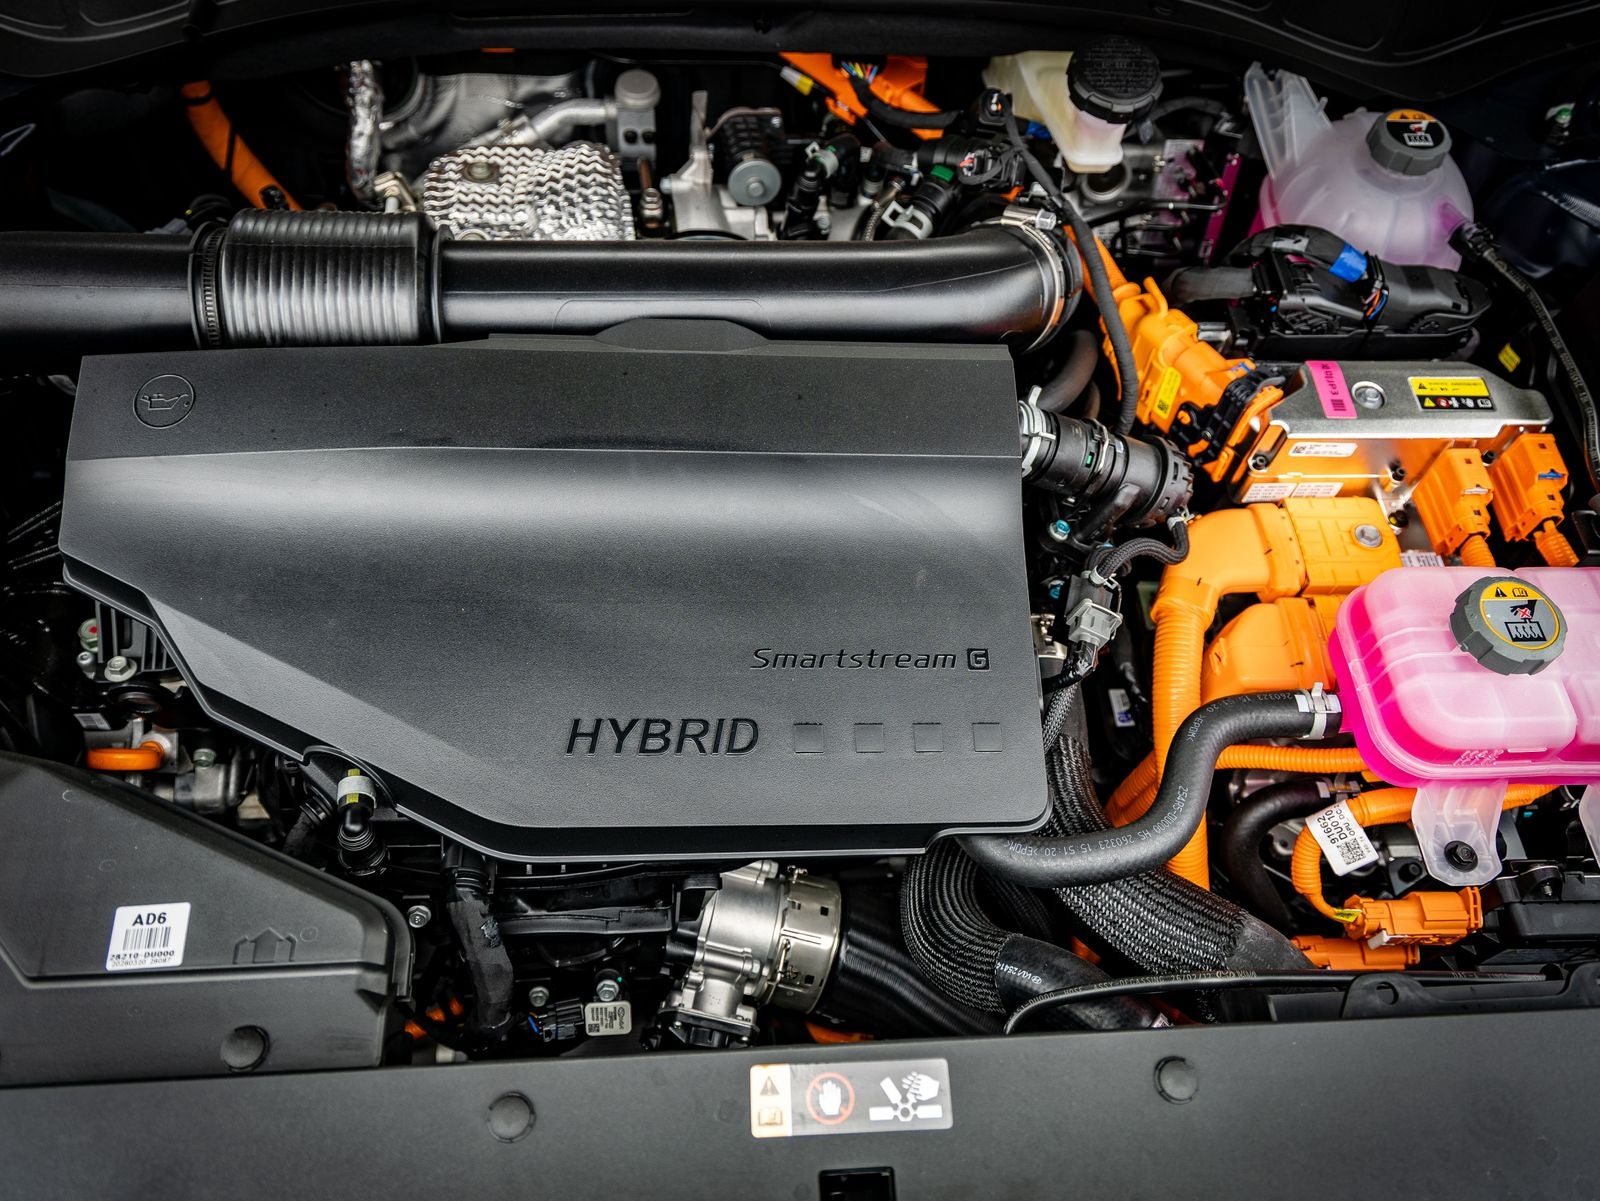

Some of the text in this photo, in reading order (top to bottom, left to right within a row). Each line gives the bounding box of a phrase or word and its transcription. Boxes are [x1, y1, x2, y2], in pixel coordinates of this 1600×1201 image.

[750, 648, 990, 670] Smartstream G
[564, 717, 760, 757] HYBRID
[1317, 815, 1339, 844] 91662
[1325, 809, 1348, 840] DU010
[1099, 834, 1135, 849] 260323
[1138, 830, 1152, 841] HS
[1044, 843, 1092, 857] 15:51:20
[132, 912, 167, 926] AD6
